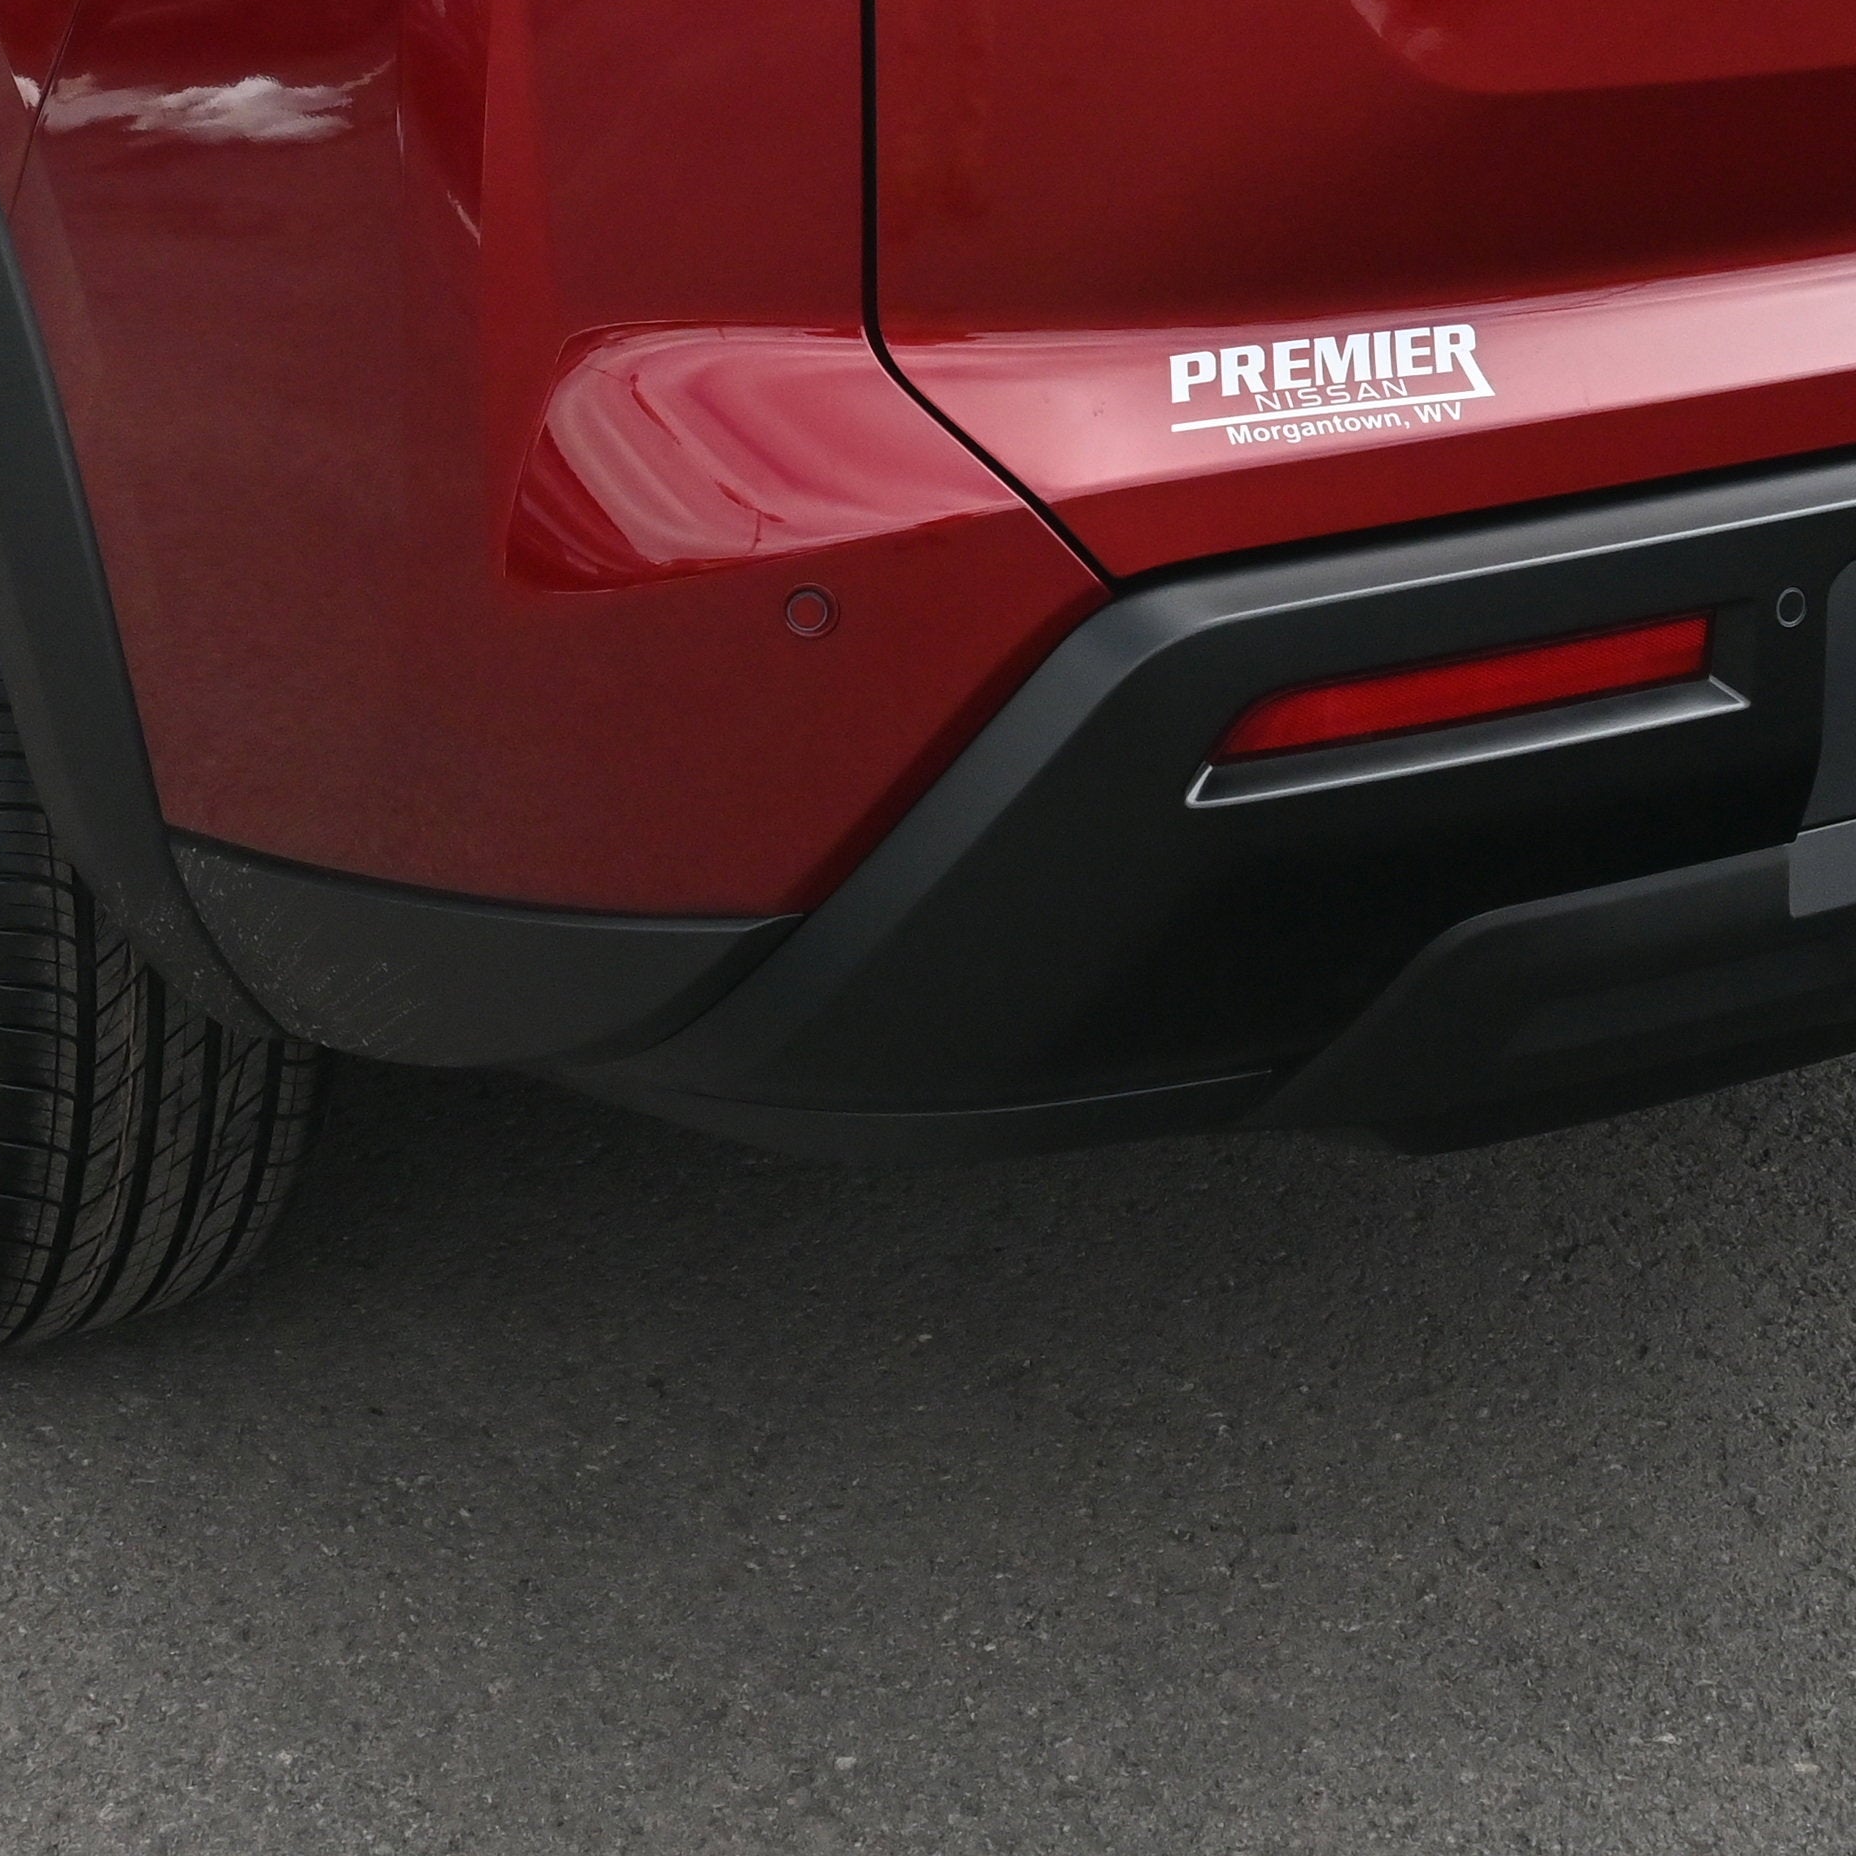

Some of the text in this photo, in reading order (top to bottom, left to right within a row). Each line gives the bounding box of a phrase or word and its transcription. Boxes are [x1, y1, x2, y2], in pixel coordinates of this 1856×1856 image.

[1169, 323, 1495, 404] PREMIER
[1254, 378, 1409, 412] NISSAN
[1226, 401, 1463, 445] Morgantown, WV
